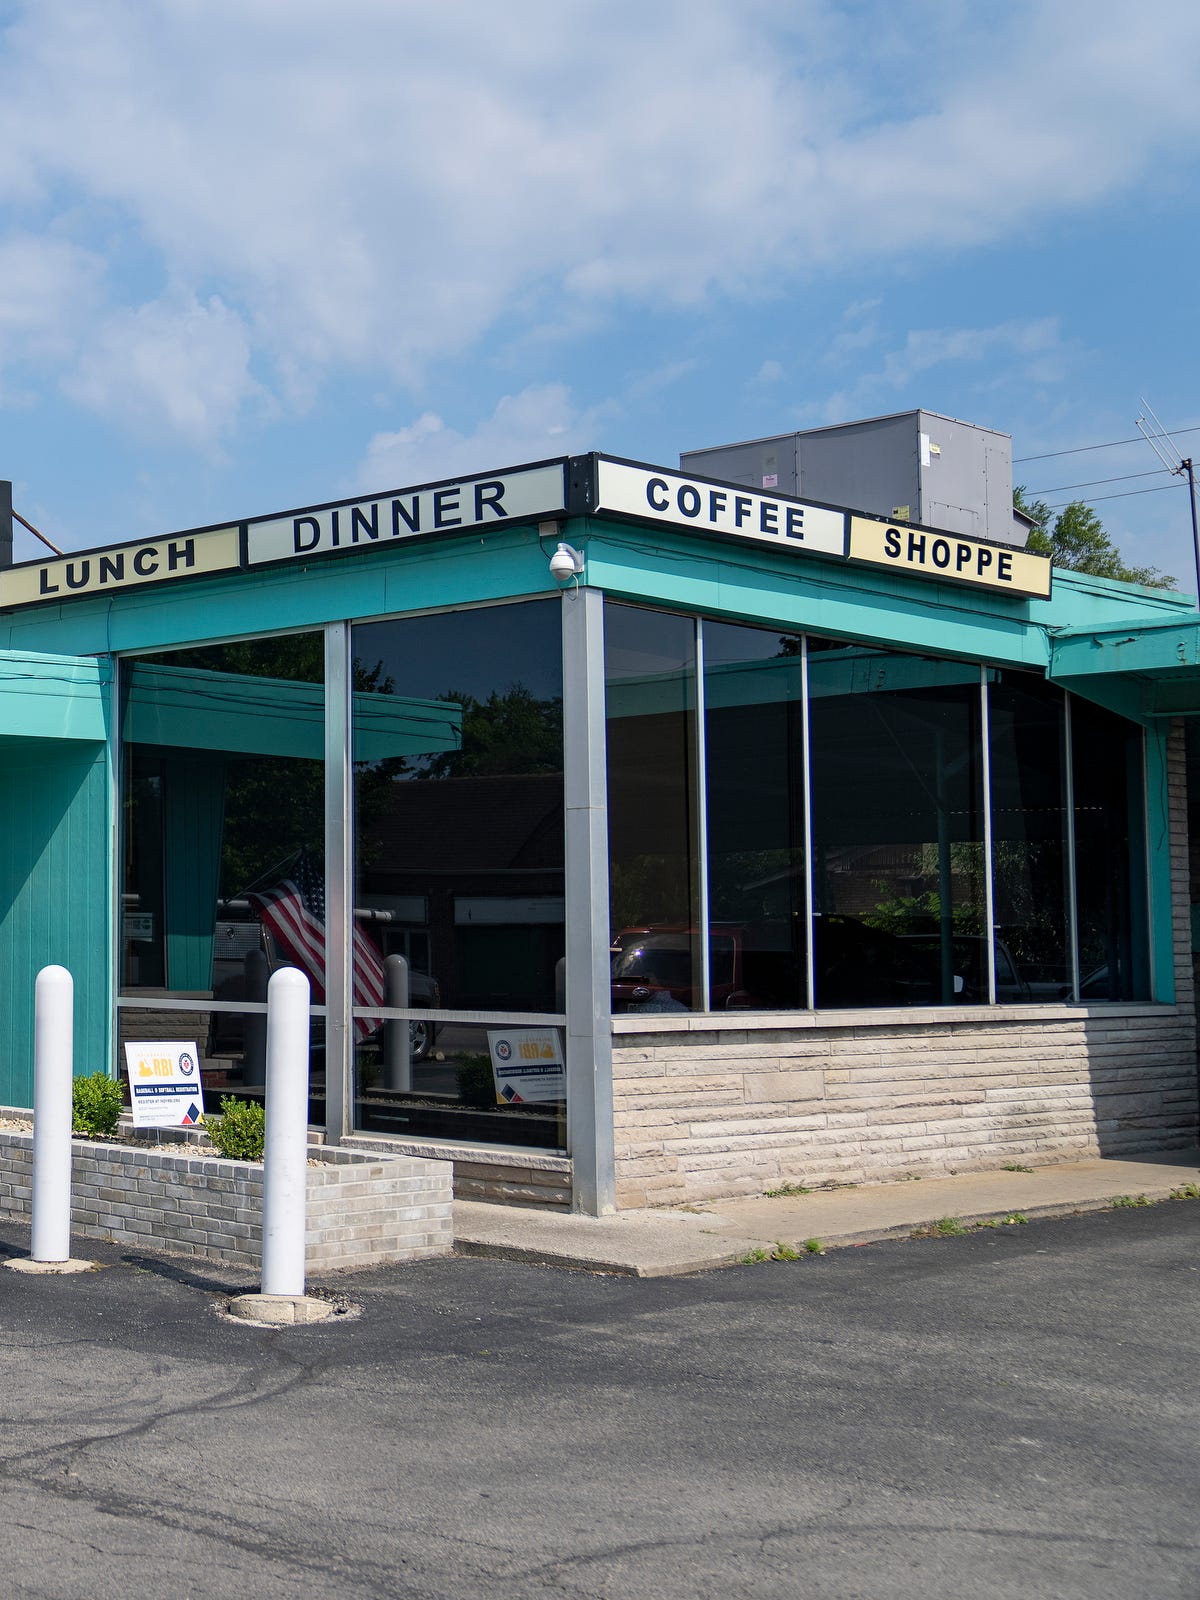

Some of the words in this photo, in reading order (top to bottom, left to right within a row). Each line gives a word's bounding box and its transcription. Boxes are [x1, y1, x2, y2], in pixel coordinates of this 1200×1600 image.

[293, 481, 509, 553] DINNER
[646, 477, 805, 540] COFFEE
[39, 538, 196, 595] LUNCH
[884, 528, 1013, 582] SHOPPE
[153, 1058, 174, 1077] RBI
